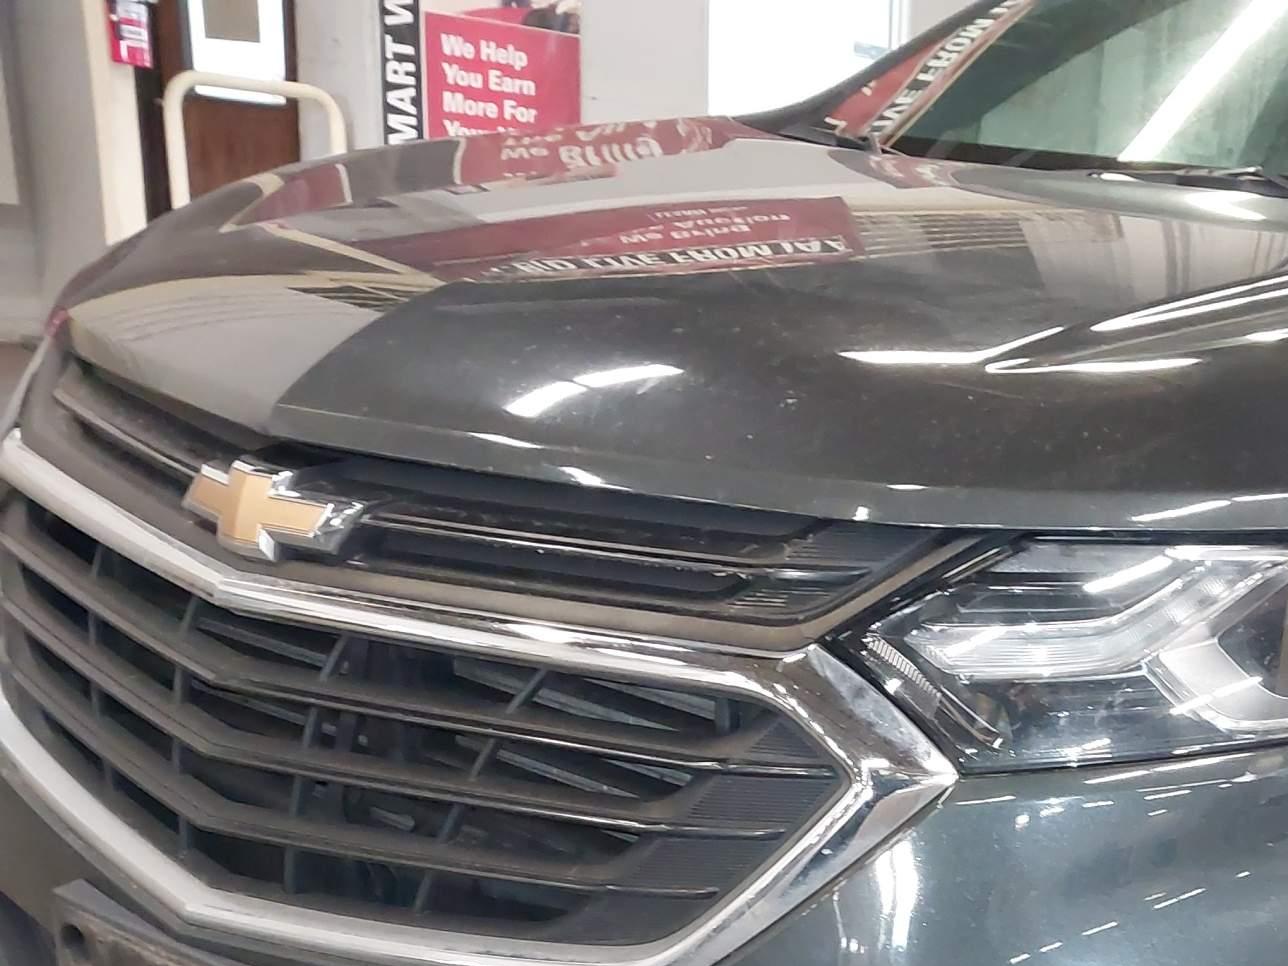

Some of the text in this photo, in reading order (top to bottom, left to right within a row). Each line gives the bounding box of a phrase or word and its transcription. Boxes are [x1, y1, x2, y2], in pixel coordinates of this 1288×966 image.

[440, 33, 529, 70] We Help
[441, 63, 537, 96] You Earn
[442, 91, 538, 124] More For
